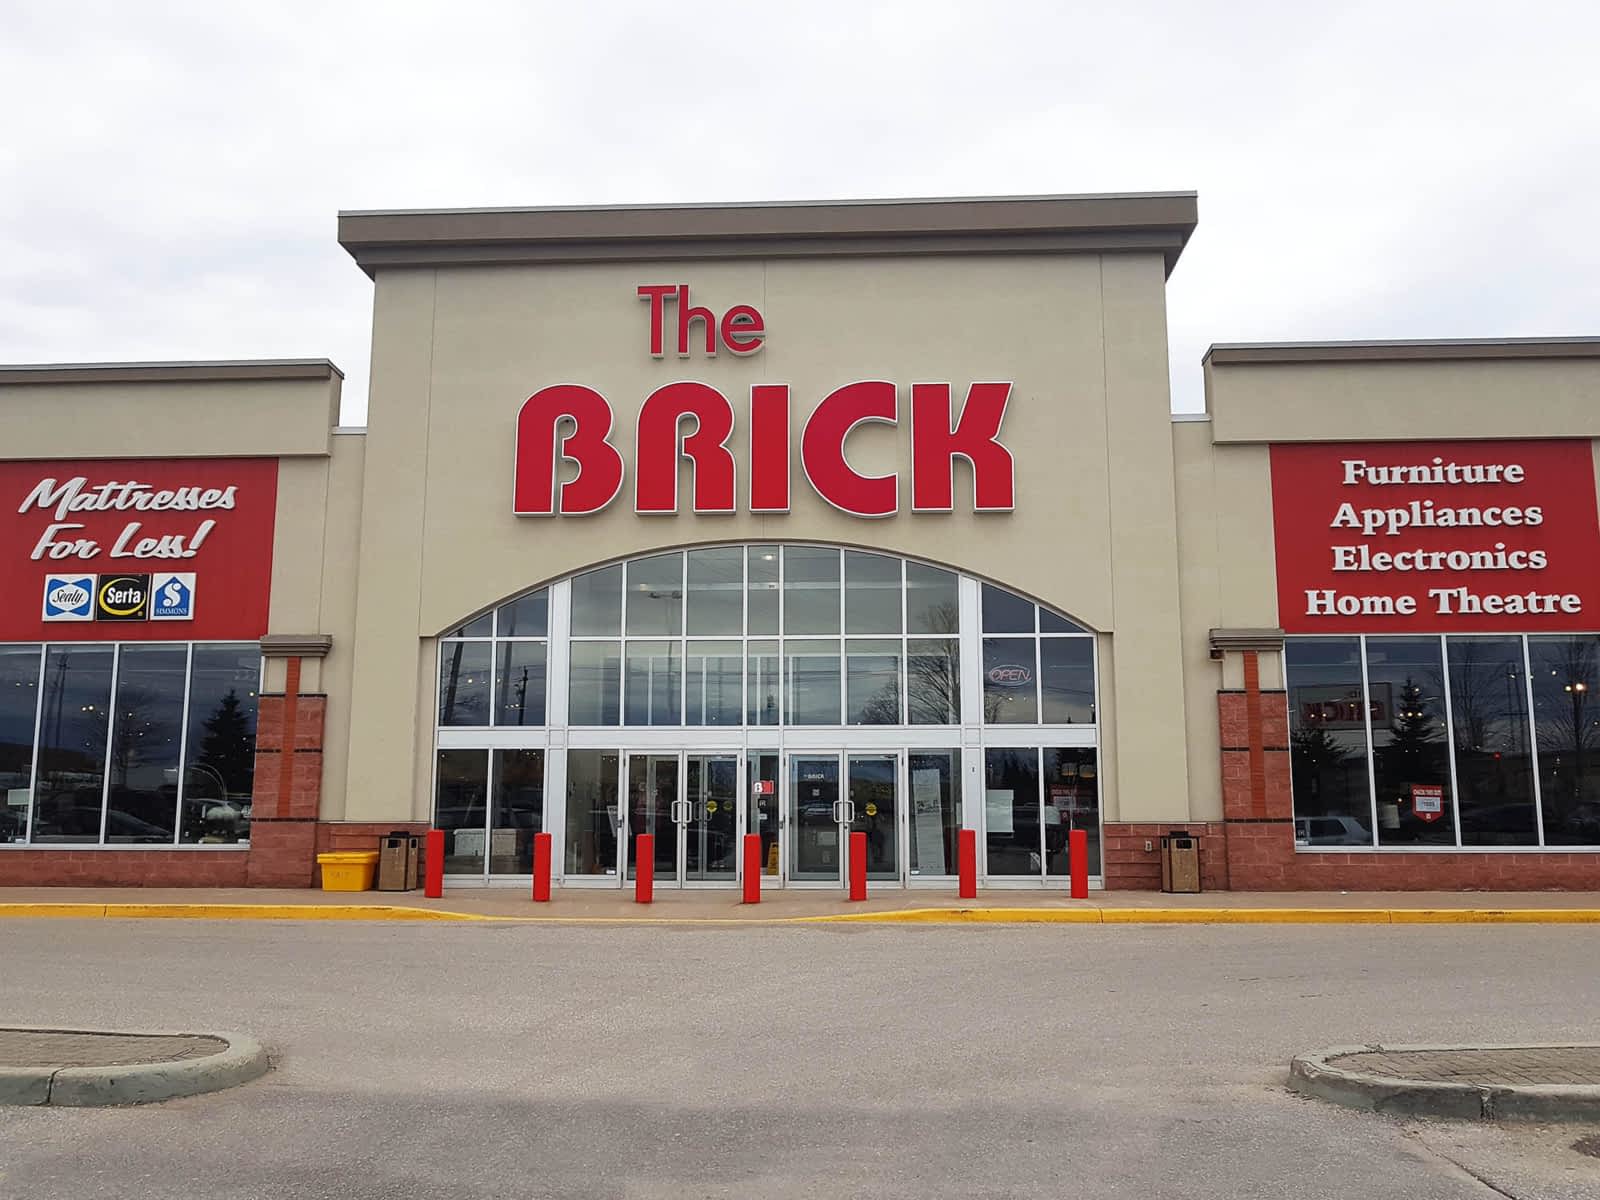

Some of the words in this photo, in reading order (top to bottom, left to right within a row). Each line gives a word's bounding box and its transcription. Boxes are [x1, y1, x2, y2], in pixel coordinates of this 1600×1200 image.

[637, 284, 765, 358] The
[512, 380, 1015, 518] BRICK
[1341, 457, 1525, 485] Furniture
[18, 477, 238, 521] Mattresses
[1330, 500, 1544, 536] Appliances
[30, 523, 101, 560] For
[109, 519, 216, 559] Less!
[1331, 542, 1548, 571] Electronics
[52, 589, 83, 604] Sealy
[106, 588, 141, 604] Serta
[1304, 589, 1417, 615] Home
[1428, 586, 1582, 614] Theatre
[156, 607, 187, 616] SIMMONS
[991, 669, 1032, 681] OPEN
